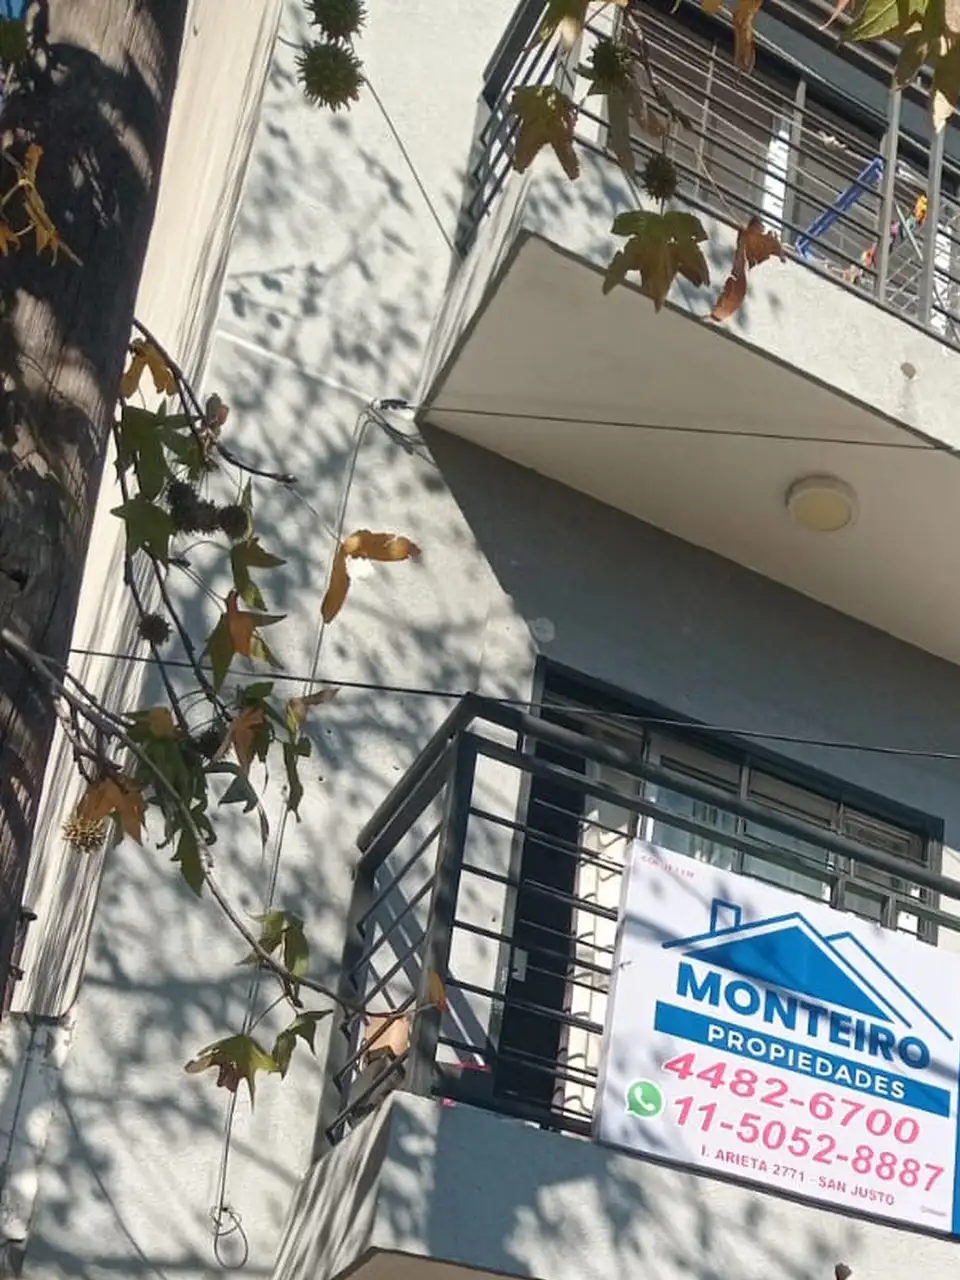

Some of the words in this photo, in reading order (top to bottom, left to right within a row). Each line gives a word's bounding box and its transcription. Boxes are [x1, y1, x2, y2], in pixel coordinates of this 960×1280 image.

[676, 961, 931, 1069] MONTEIRO
[707, 1023, 905, 1099] PROPIEDADES
[663, 1052, 920, 1145] 4482-6700
[674, 1096, 944, 1192] 11-5052-8887
[714, 1149, 767, 1172] ARIETA
[773, 1164, 805, 1183] 2771
[818, 1175, 847, 1193] SAN
[851, 1185, 895, 1206] JUSTO
